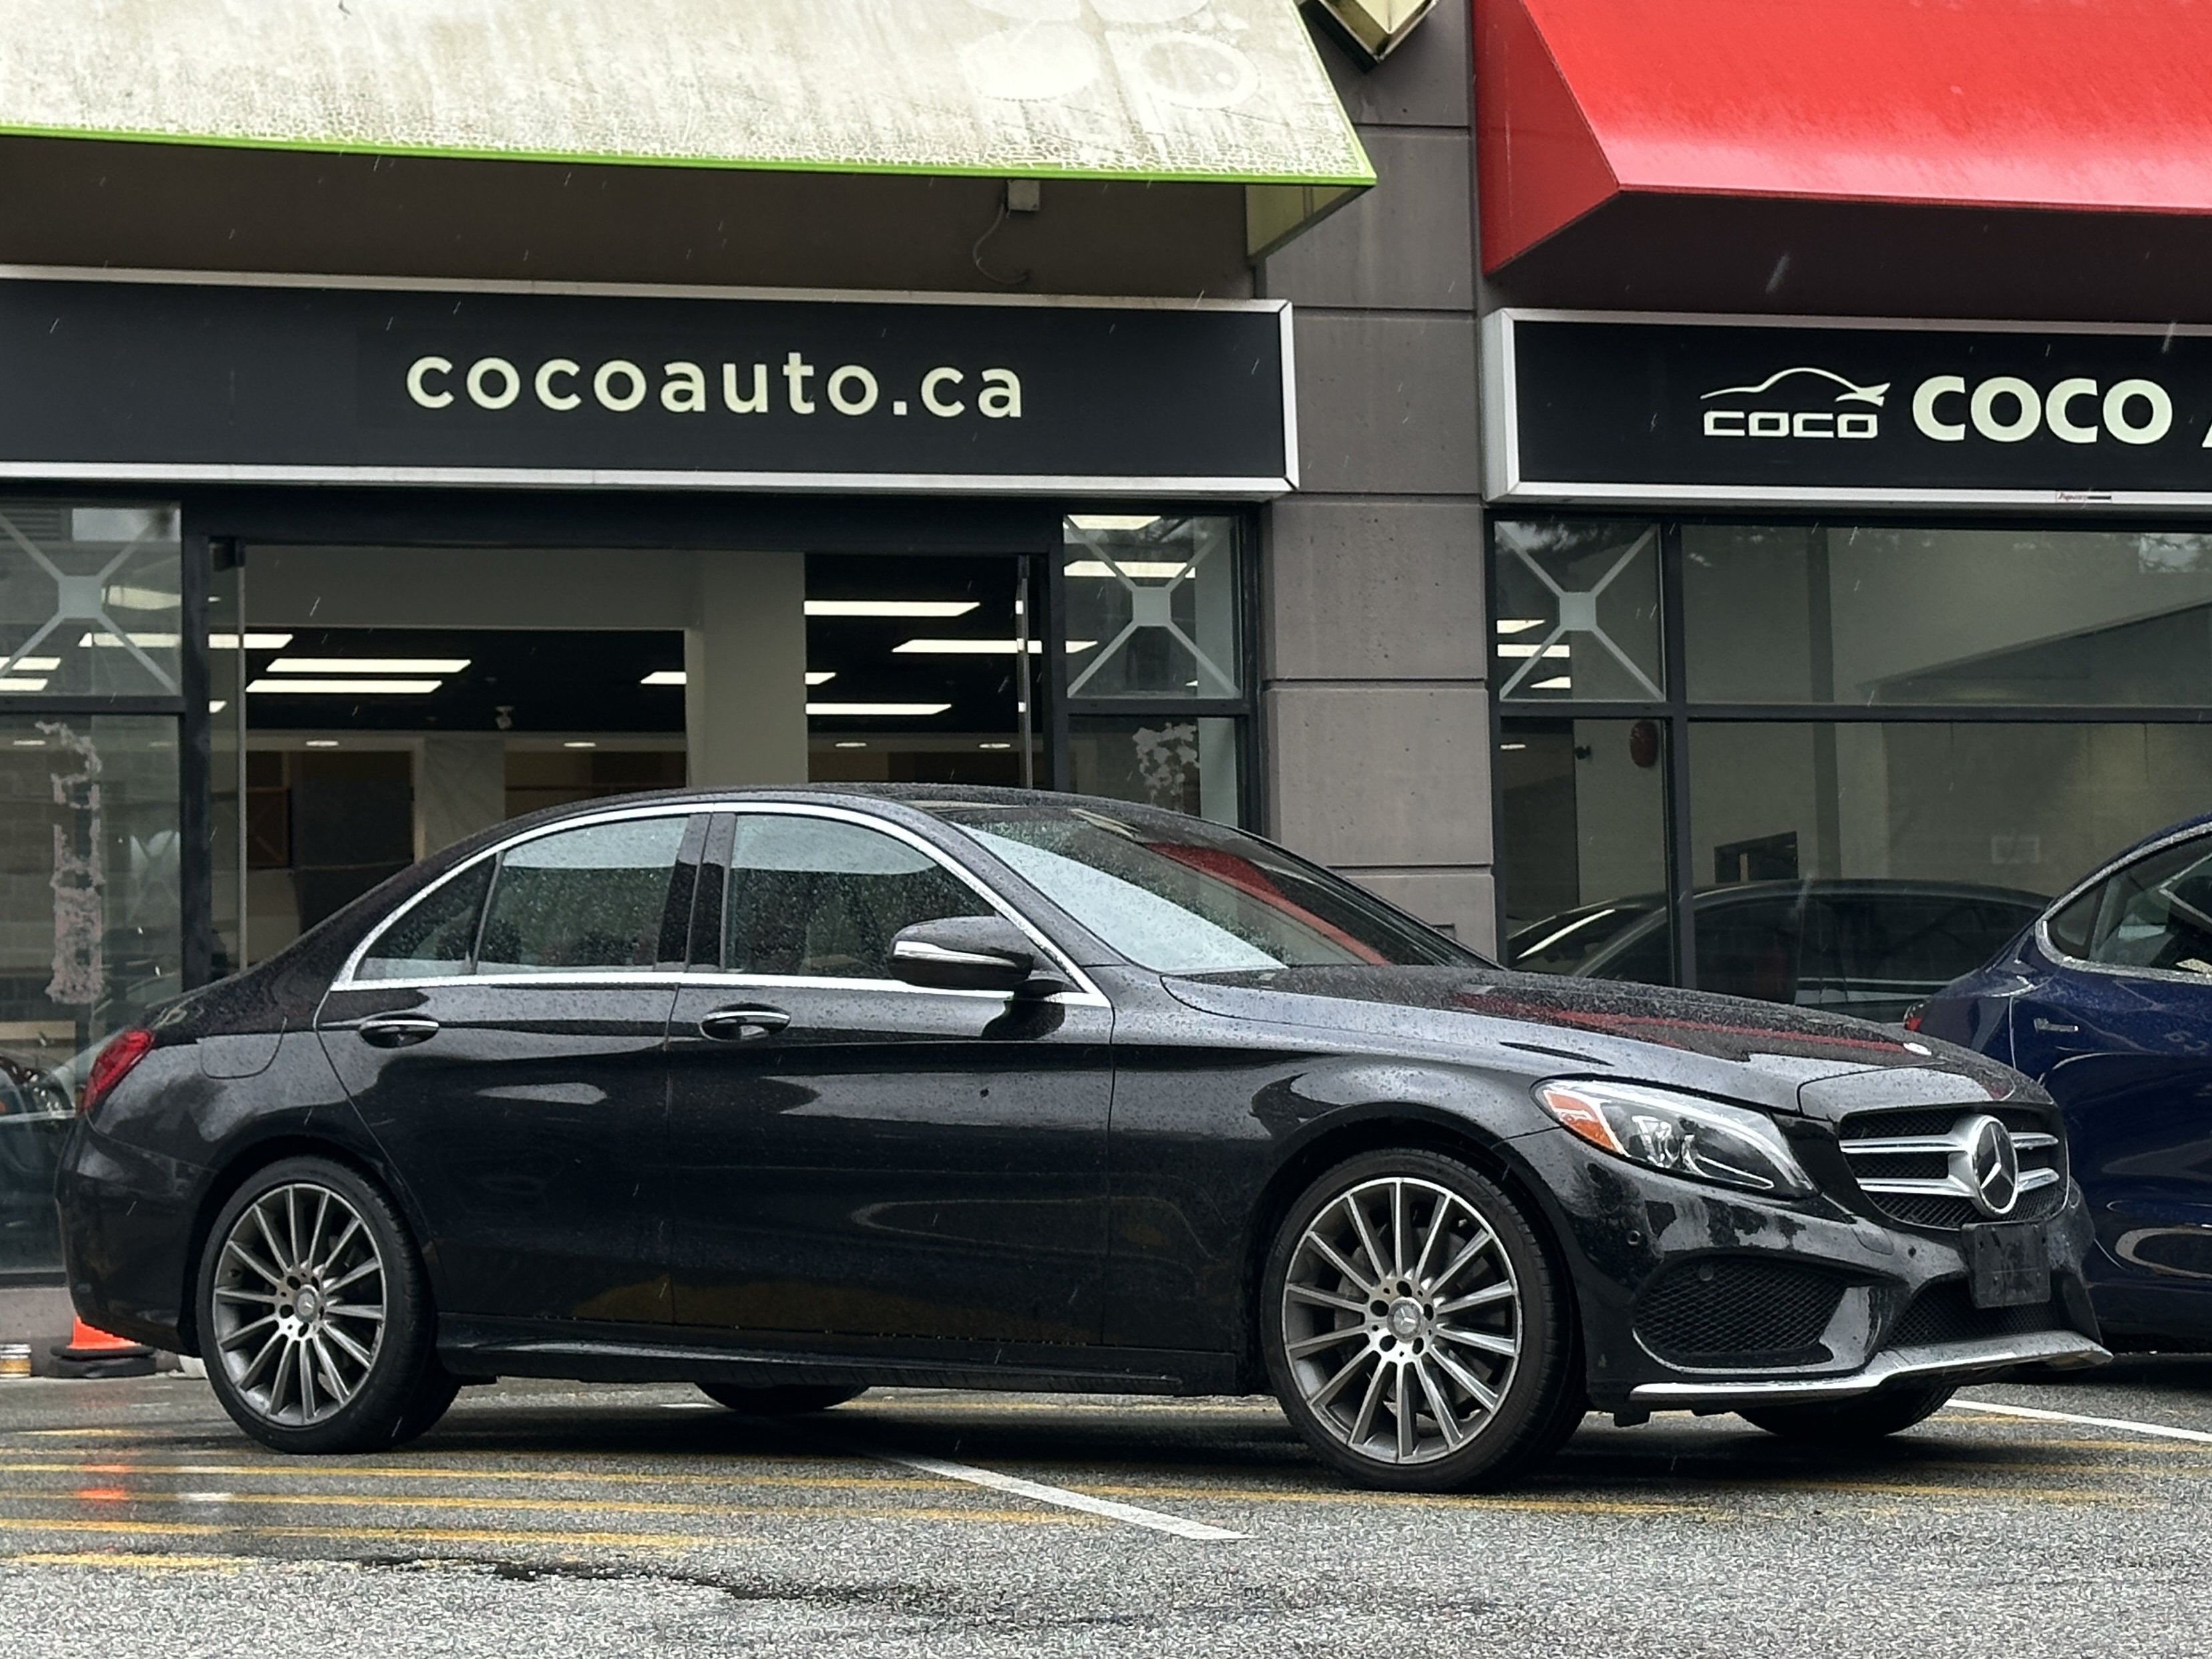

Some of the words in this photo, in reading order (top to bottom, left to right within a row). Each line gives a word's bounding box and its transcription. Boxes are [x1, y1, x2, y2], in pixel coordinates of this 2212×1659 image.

[407, 352, 1021, 418] cocoauto.ca
[1912, 375, 2173, 445] COCO
[1703, 410, 1878, 439] COCO
